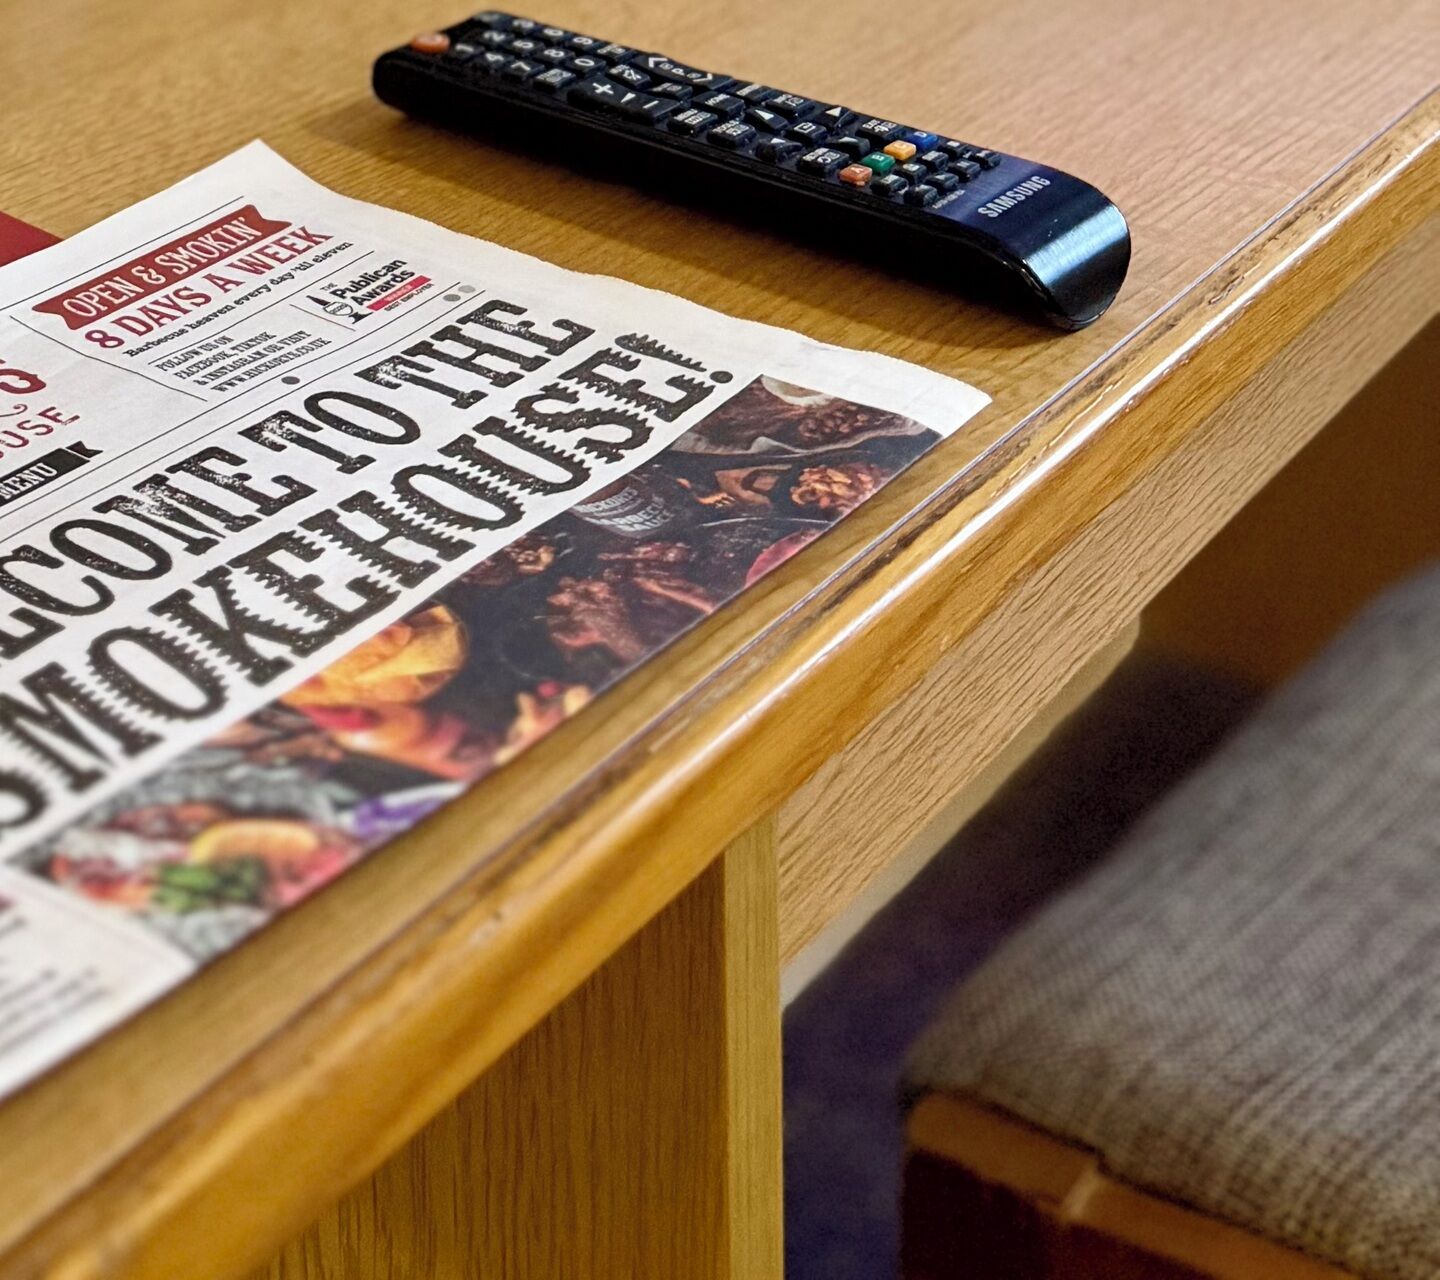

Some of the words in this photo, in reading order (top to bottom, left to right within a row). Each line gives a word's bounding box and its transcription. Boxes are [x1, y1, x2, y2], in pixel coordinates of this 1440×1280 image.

[484, 30, 506, 41] 2
[544, 49, 564, 58] 8
[574, 58, 595, 67] 0
[485, 52, 504, 62] 4
[511, 62, 530, 71] 7
[978, 175, 1051, 218] SAMSUNG
[63, 276, 144, 317] OPEN
[131, 265, 166, 285] &
[154, 216, 262, 275] SMOKIN'
[86, 329, 125, 349] 8
[111, 286, 212, 336] DAYS
[202, 273, 246, 293] A
[225, 226, 334, 276] WEEK
[329, 259, 408, 299] Publican
[350, 270, 415, 306] Awards
[123, 326, 188, 358] Barbecue
[184, 303, 236, 330] heaven
[234, 282, 271, 306] every
[270, 271, 295, 286] day
[313, 242, 354, 263] eleven
[155, 348, 203, 372] FOLLOW
[198, 343, 216, 352] US
[214, 335, 235, 346] ON
[174, 350, 239, 380] FACEBOOK,
[230, 331, 277, 353] TIKTOK
[193, 378, 209, 386] &
[202, 350, 270, 381] INSTAGRAM
[264, 342, 285, 353] OR
[276, 329, 312, 346] VISIT
[240, 382, 426, 483] TO
[357, 294, 602, 423] THE
